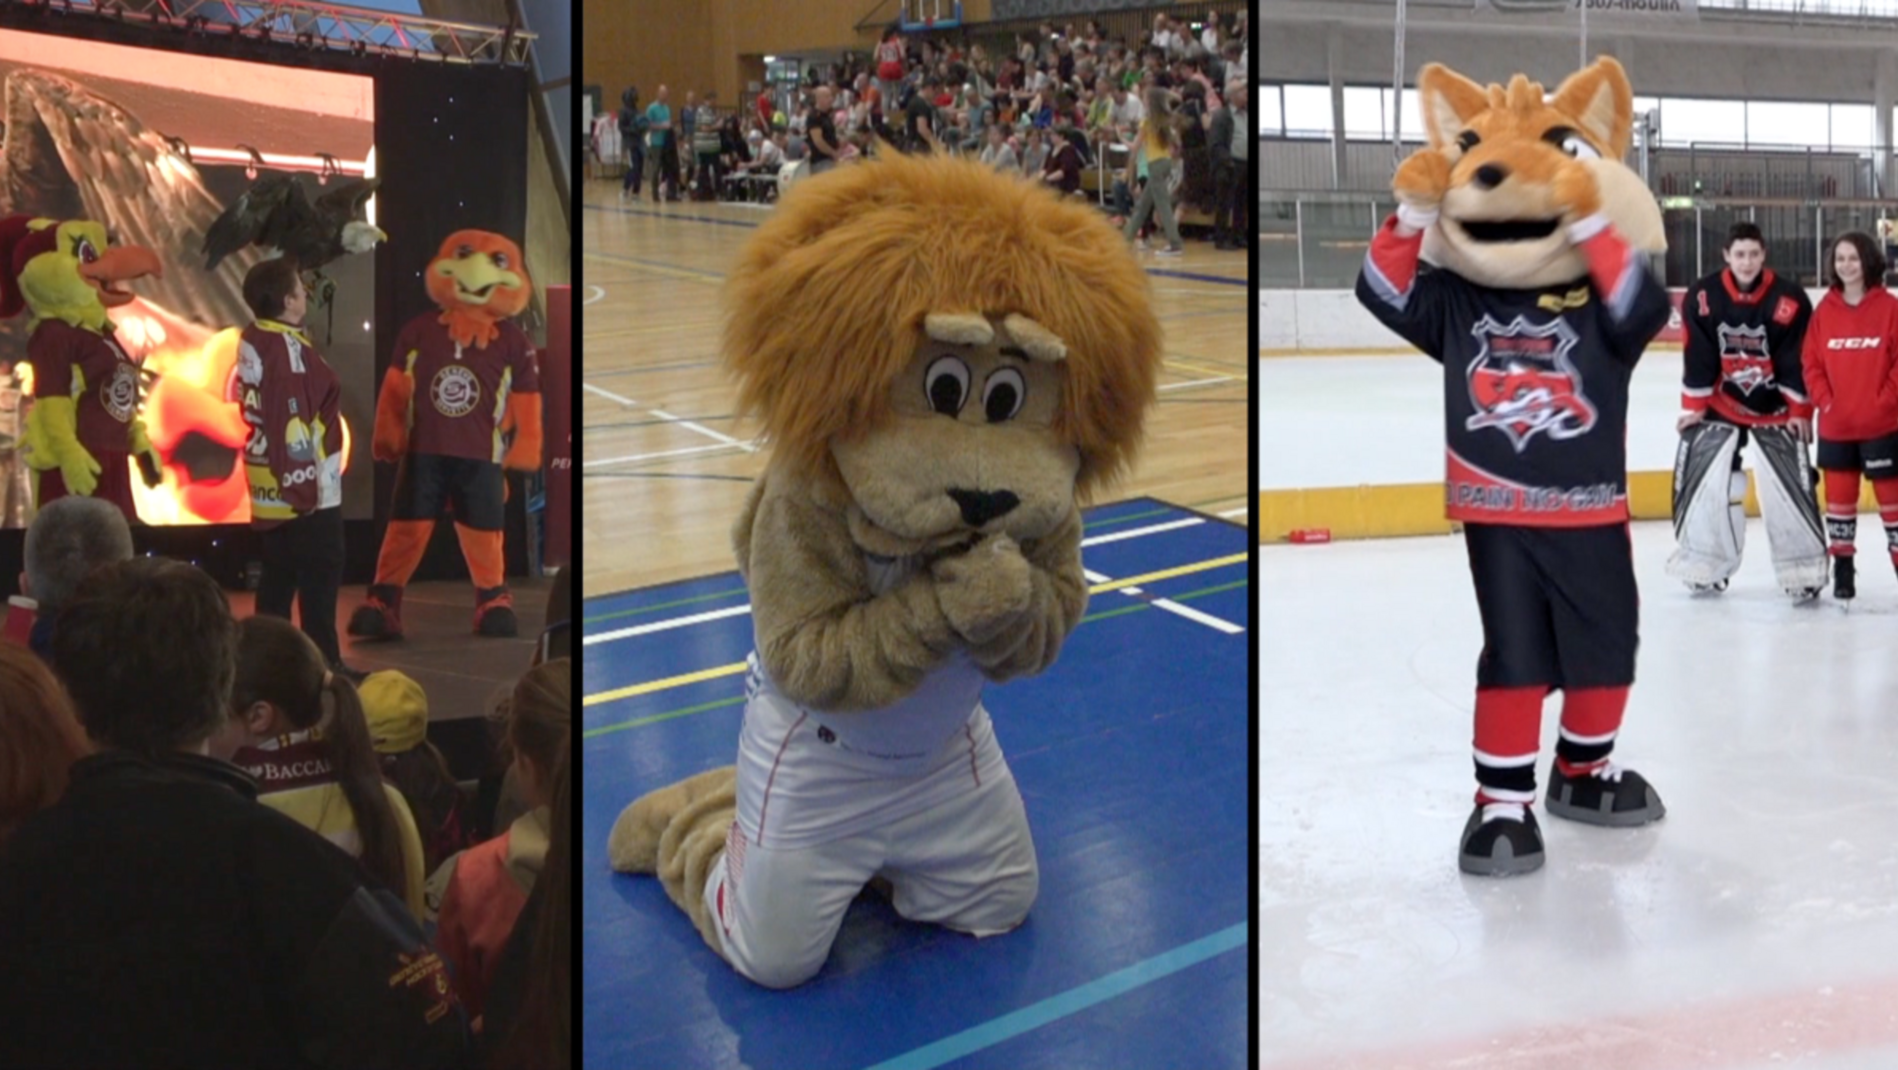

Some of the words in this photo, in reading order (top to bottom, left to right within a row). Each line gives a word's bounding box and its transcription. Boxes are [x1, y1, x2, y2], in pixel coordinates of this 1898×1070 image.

[1697, 289, 1709, 316] 1
[1827, 336, 1881, 349] CCM
[1457, 482, 1515, 512] PAIN
